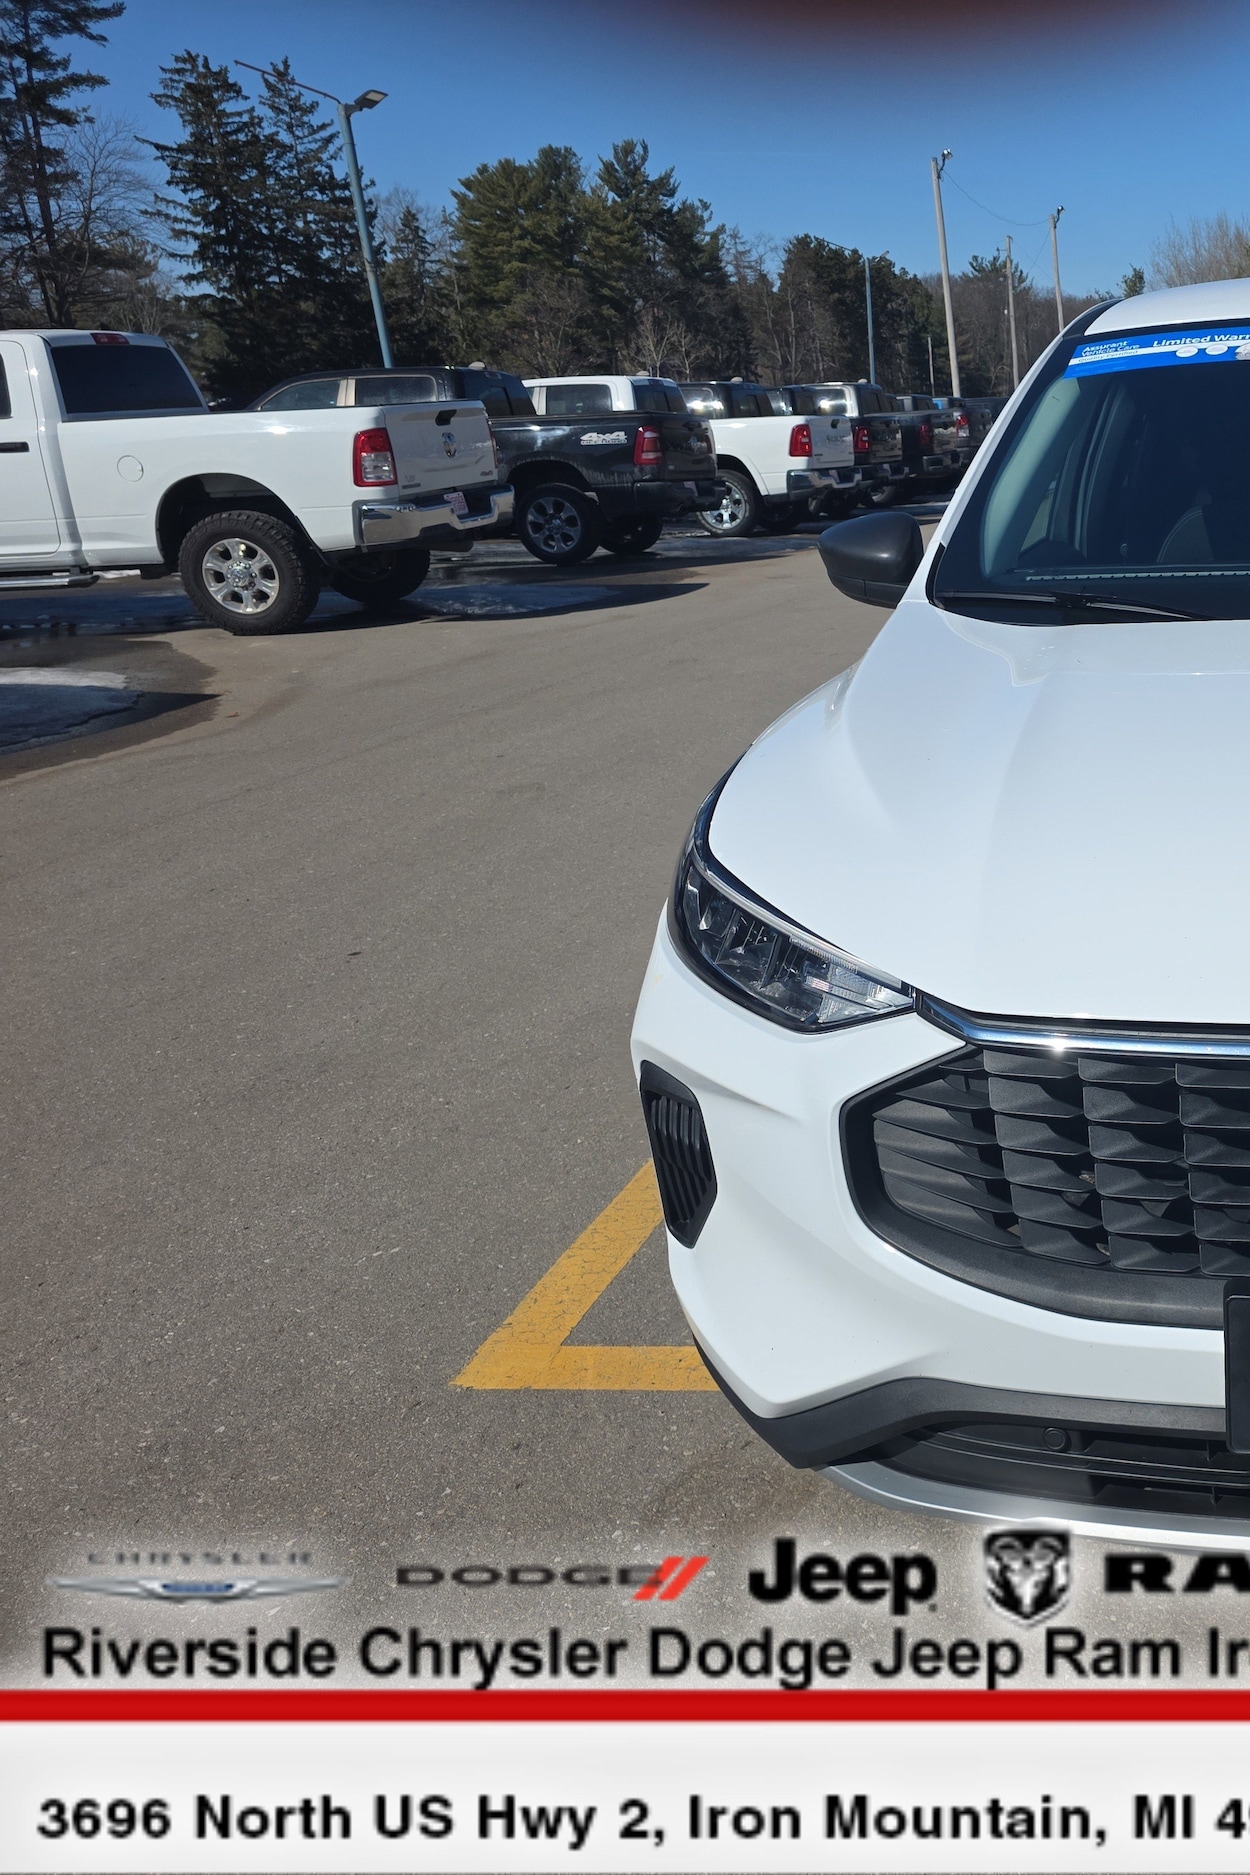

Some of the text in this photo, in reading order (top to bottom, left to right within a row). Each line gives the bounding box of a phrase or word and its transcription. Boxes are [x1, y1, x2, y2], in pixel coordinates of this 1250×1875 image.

[1082, 341, 1128, 352] Assurant
[1152, 335, 1211, 347] Limited
[1081, 344, 1140, 357] Vehicle Care
